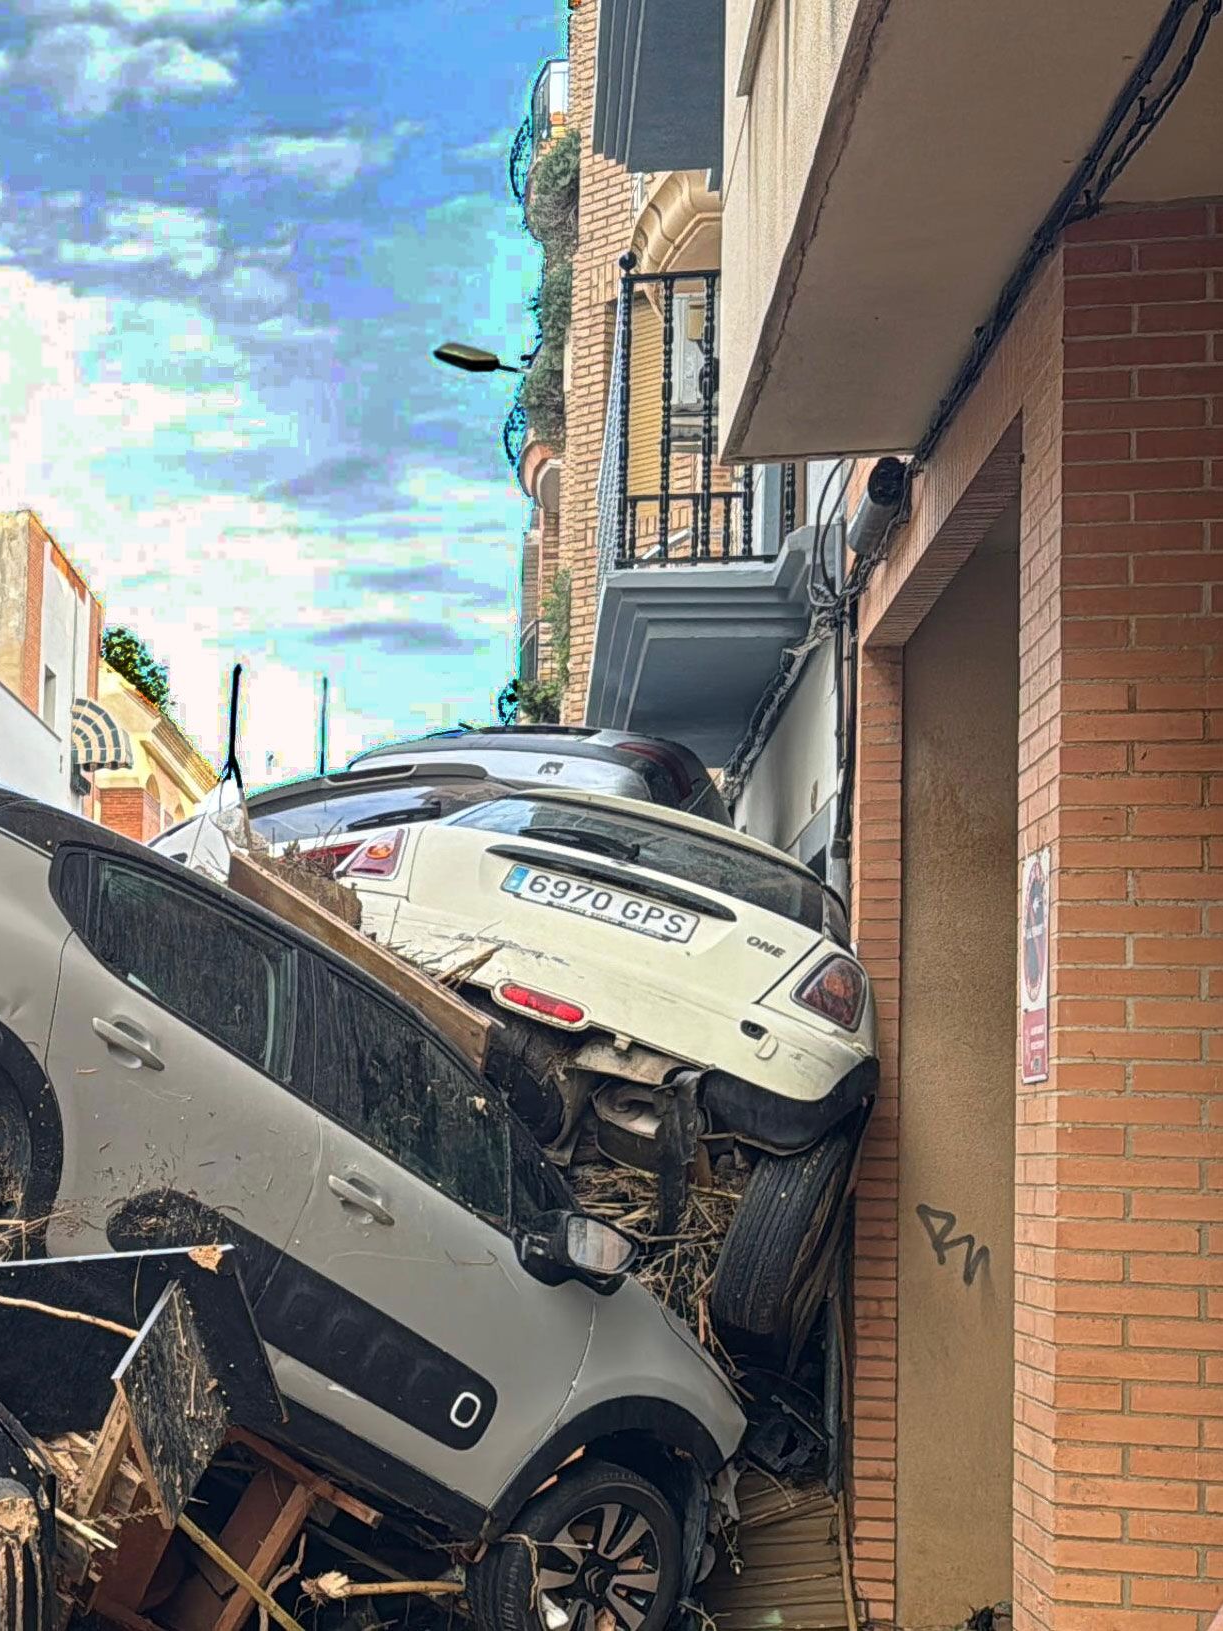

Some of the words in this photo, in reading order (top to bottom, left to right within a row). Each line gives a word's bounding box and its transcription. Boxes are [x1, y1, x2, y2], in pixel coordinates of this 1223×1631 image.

[528, 874, 614, 911] 6970
[621, 900, 687, 934] GPS
[746, 935, 787, 959] ONE
